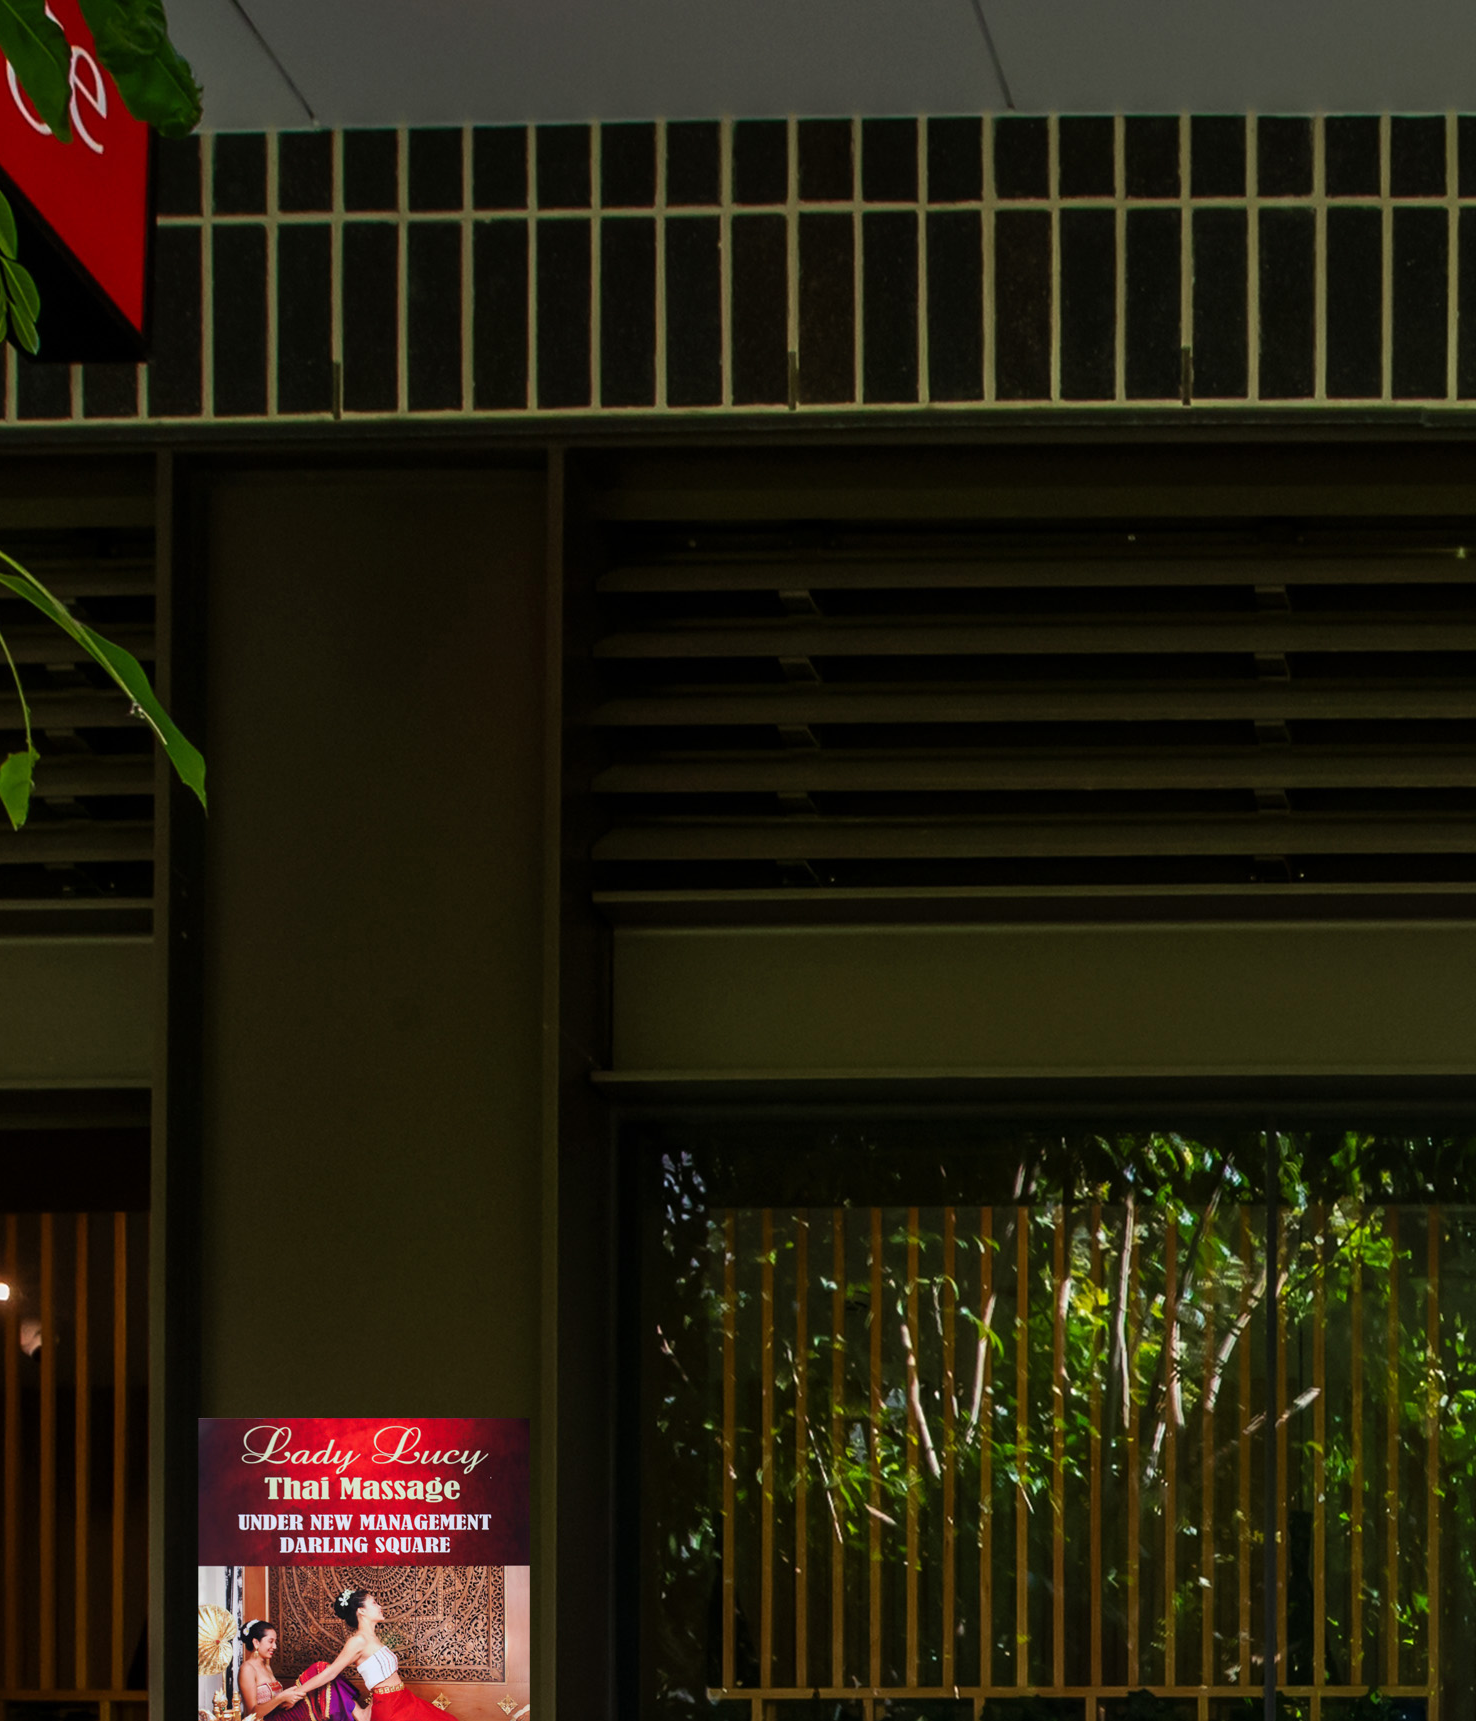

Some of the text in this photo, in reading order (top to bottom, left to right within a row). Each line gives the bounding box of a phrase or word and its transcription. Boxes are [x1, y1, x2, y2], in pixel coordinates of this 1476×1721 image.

[242, 1426, 489, 1474] Lady Lucy
[264, 1477, 461, 1503] Thai Massage
[238, 1514, 491, 1531] UNDER NEW MANAGEMENT
[280, 1537, 450, 1555] DARLING SQUARE
